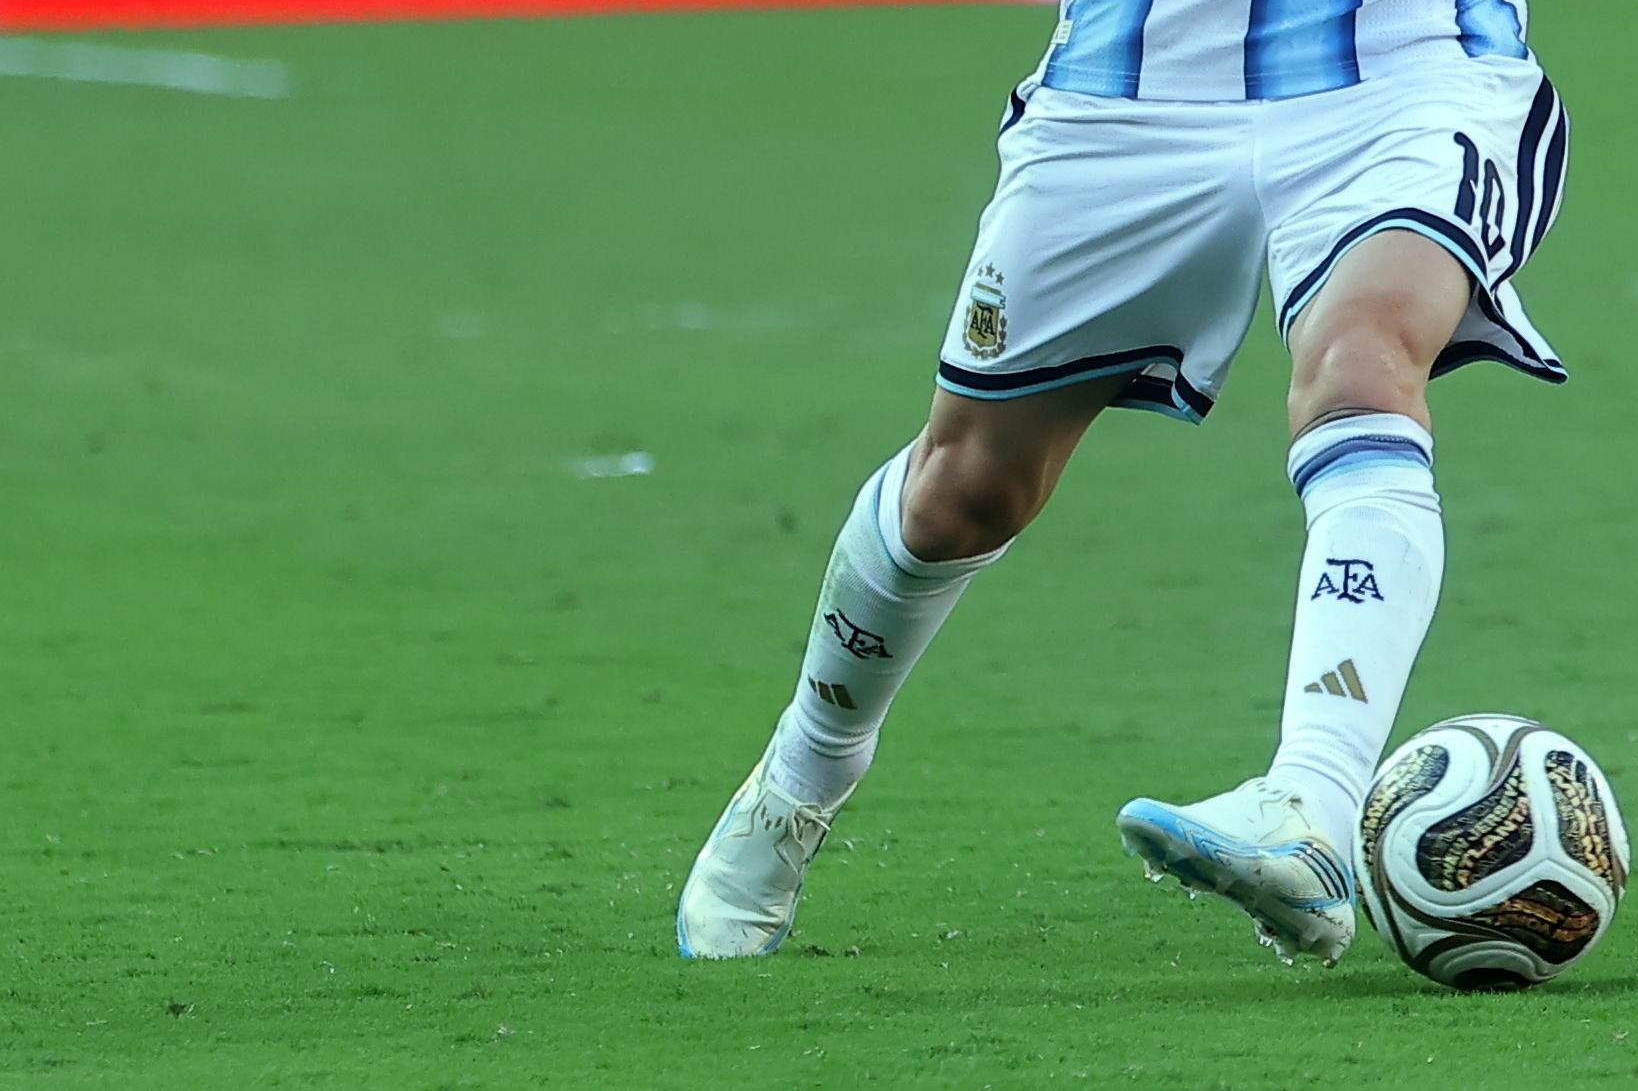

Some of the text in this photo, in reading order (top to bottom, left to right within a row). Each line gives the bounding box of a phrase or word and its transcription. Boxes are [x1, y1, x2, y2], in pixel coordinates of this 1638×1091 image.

[1453, 131, 1506, 262] 10
[970, 302, 995, 339] AFA
[1311, 558, 1384, 603] AFA
